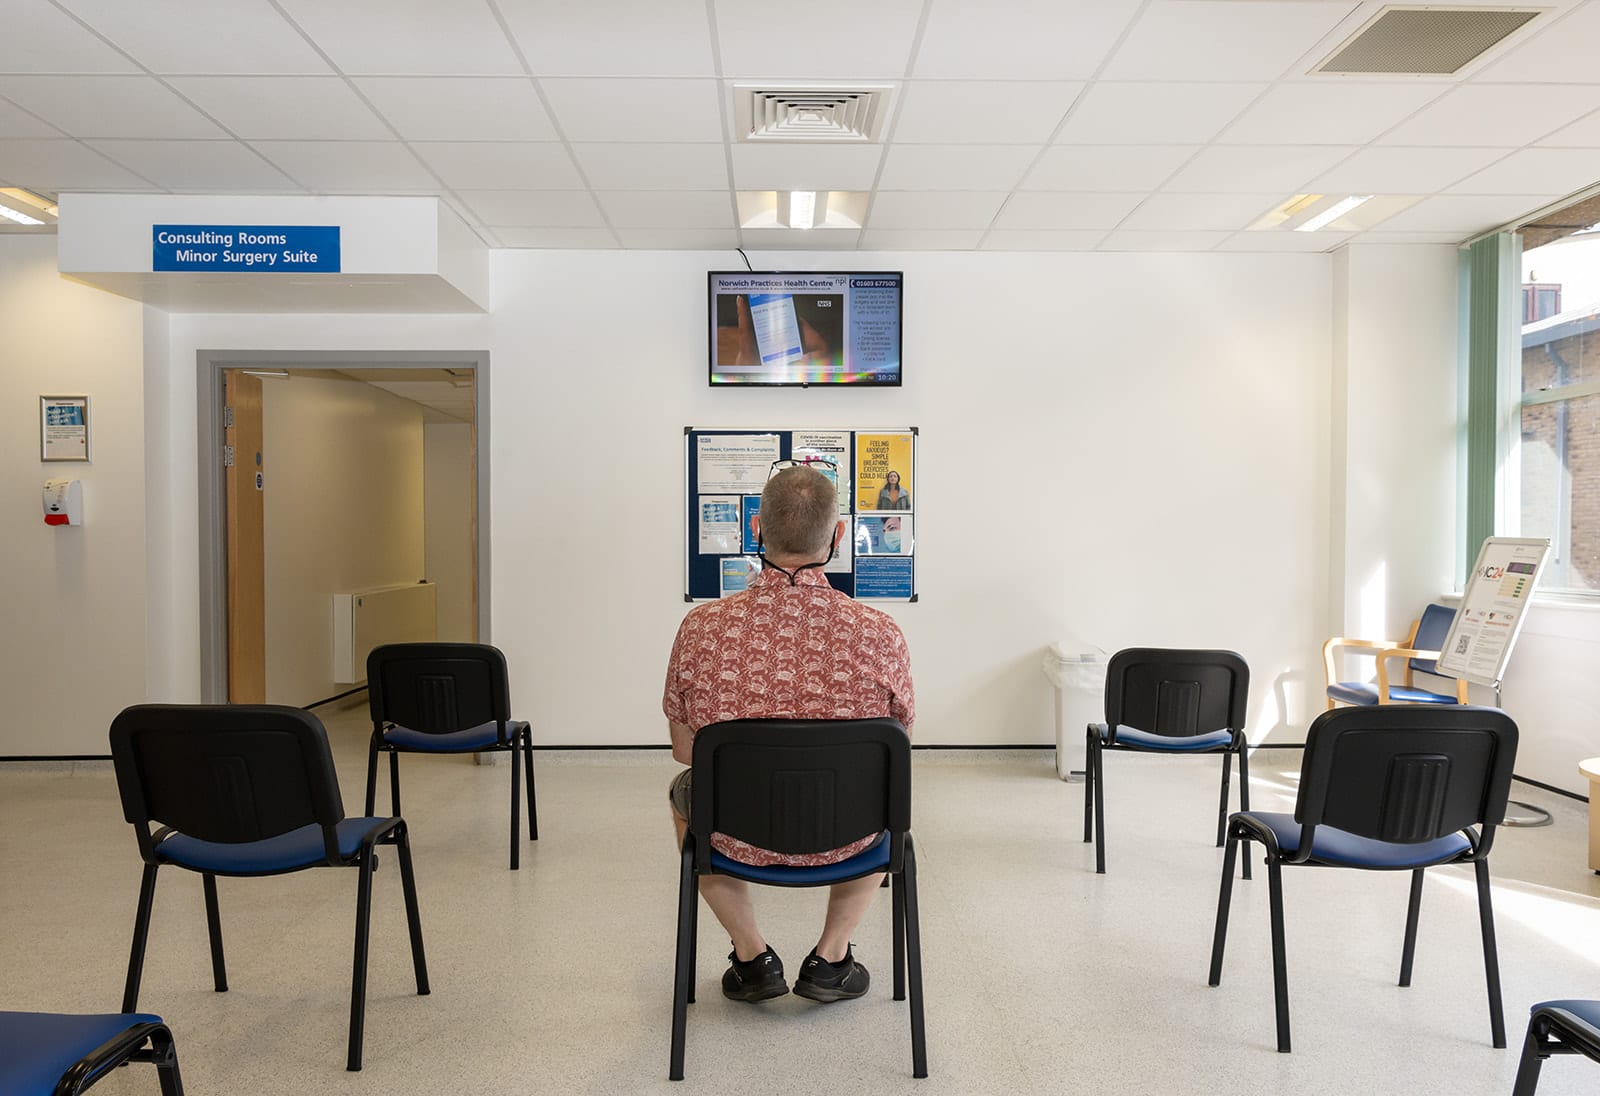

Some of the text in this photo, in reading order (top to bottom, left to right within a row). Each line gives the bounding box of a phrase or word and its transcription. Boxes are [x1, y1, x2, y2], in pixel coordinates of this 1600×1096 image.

[158, 230, 287, 247] Consulting Rooms
[176, 249, 318, 265] Minor Surgery Suite
[718, 279, 833, 287] Norwich Practices Health Centre
